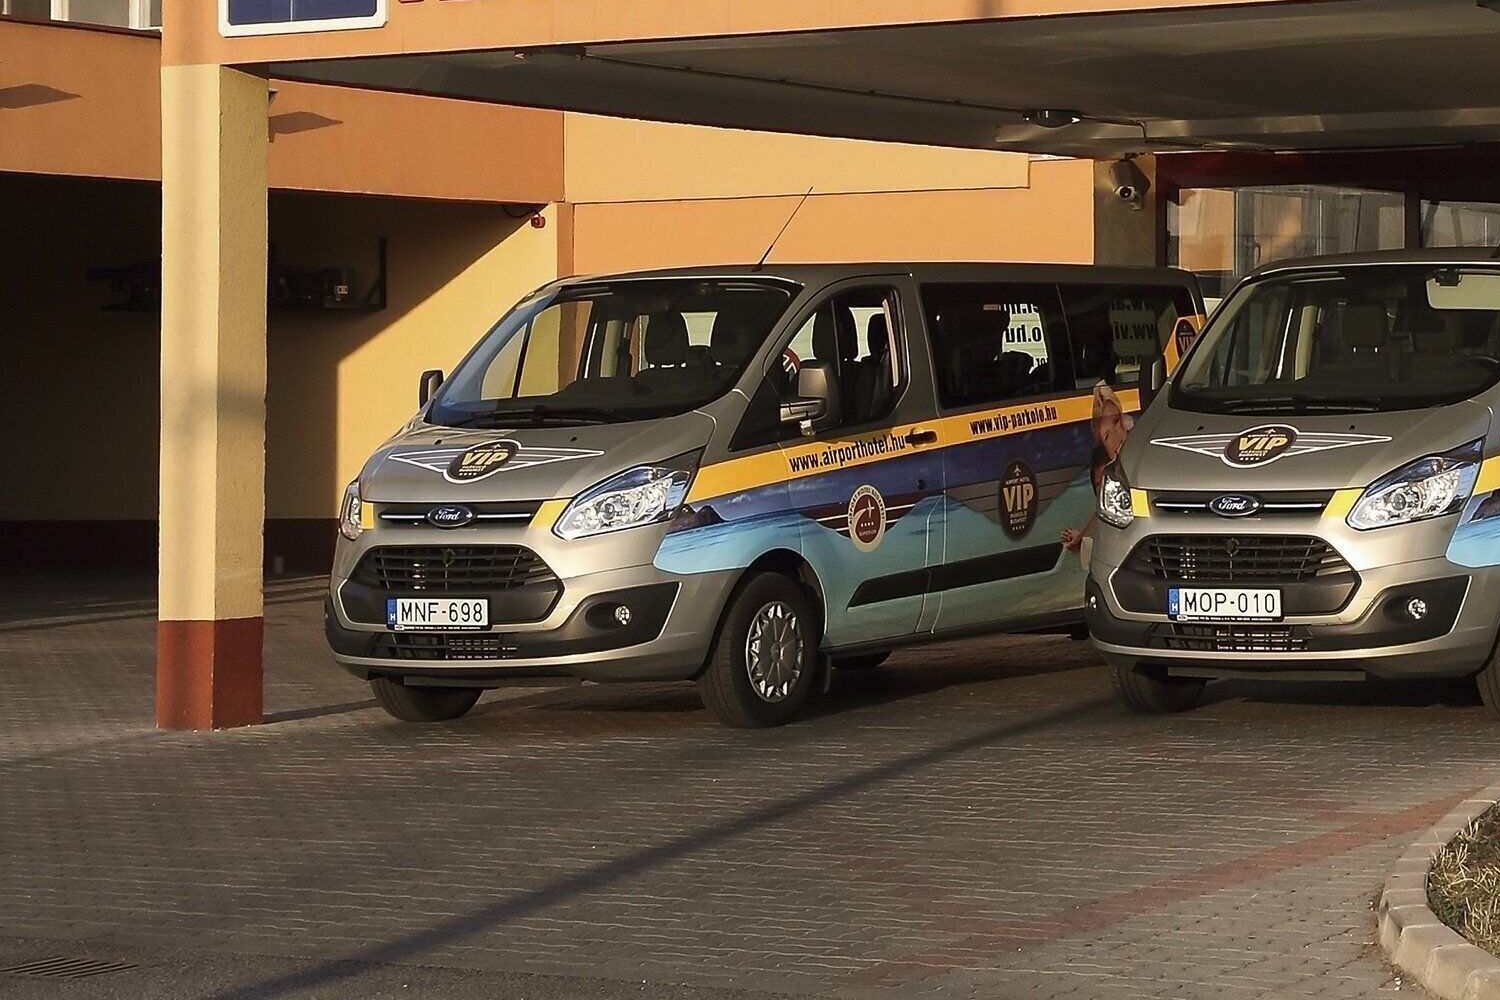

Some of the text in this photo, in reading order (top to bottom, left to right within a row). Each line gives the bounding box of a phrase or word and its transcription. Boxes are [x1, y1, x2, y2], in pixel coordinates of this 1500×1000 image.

[970, 405, 1057, 435] www.vip-parkolo.hu
[789, 433, 905, 473] www.airporthotel.hu
[1238, 437, 1288, 450] VIP
[462, 452, 509, 465] VIP
[1003, 483, 1034, 512] VIP
[1218, 497, 1247, 510] Ford
[435, 508, 461, 520] Ford
[401, 601, 483, 622] MNF-698
[1184, 592, 1275, 613] MOP-010
